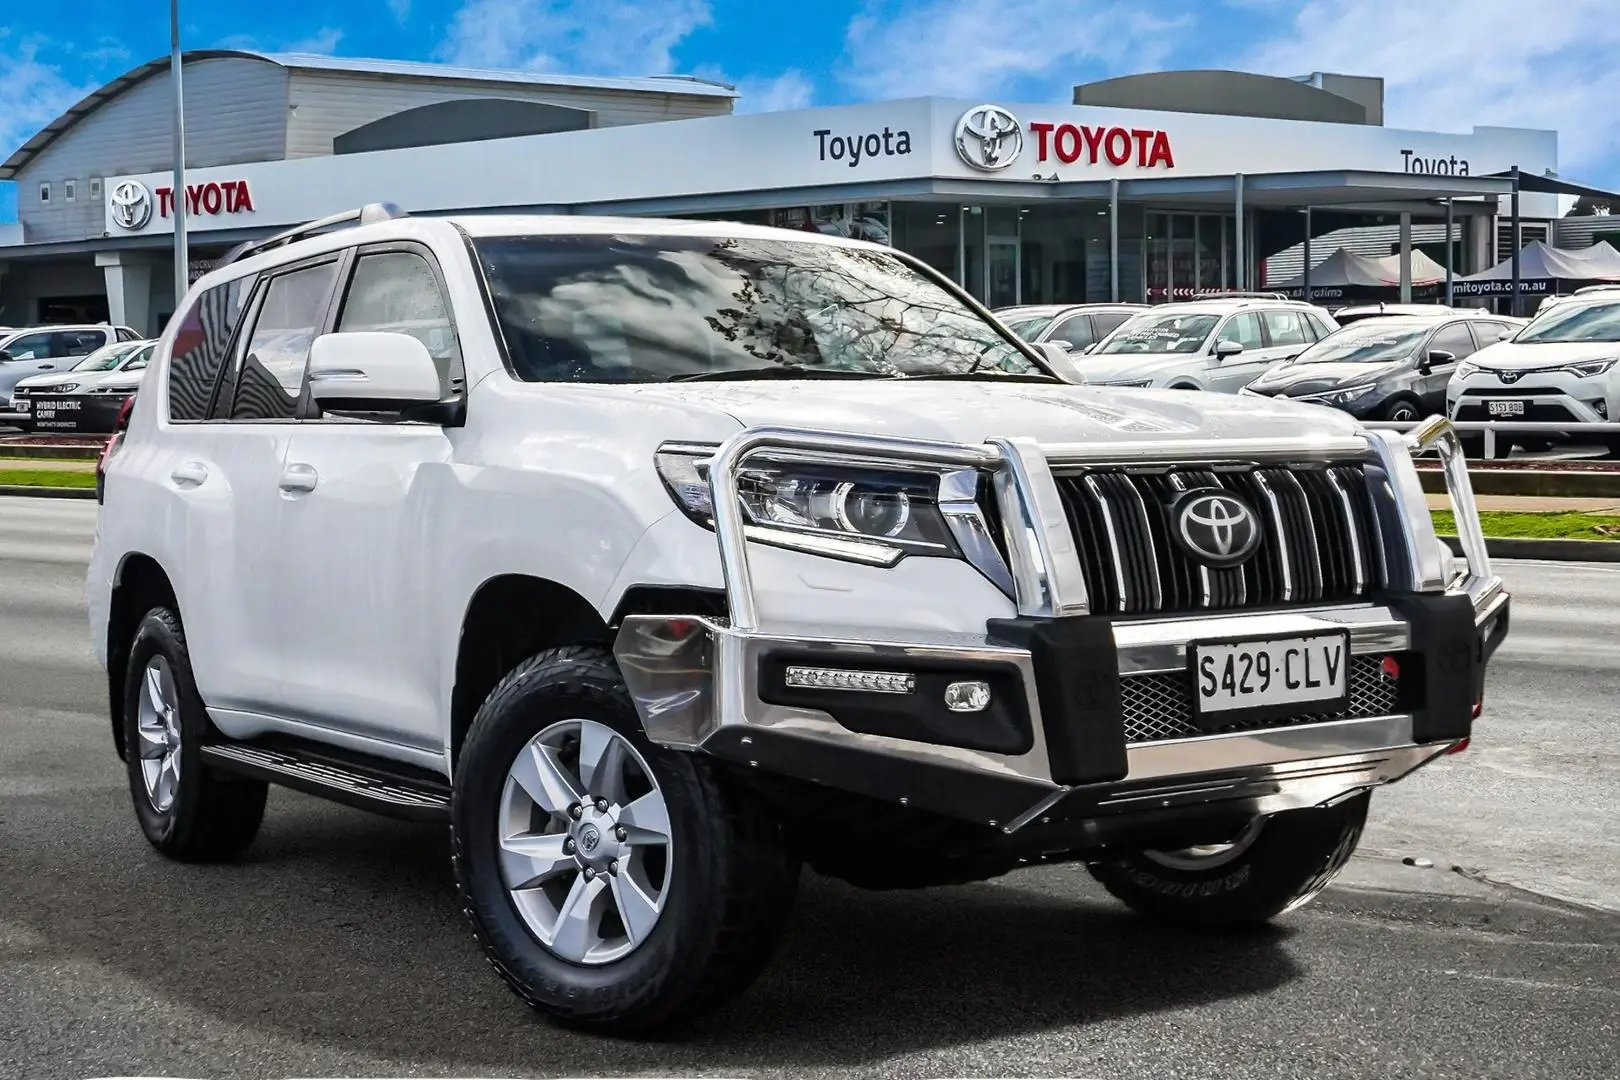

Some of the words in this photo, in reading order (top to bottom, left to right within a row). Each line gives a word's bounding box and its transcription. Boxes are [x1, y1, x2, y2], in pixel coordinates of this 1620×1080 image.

[813, 127, 911, 168] Toyota
[1030, 122, 1175, 168] TOYOTA
[1453, 281, 1546, 295] mitoyota.cm.au
[36, 401, 56, 410] HYBRID
[56, 401, 81, 410] ELECTRIC
[36, 410, 56, 419] CAMRY
